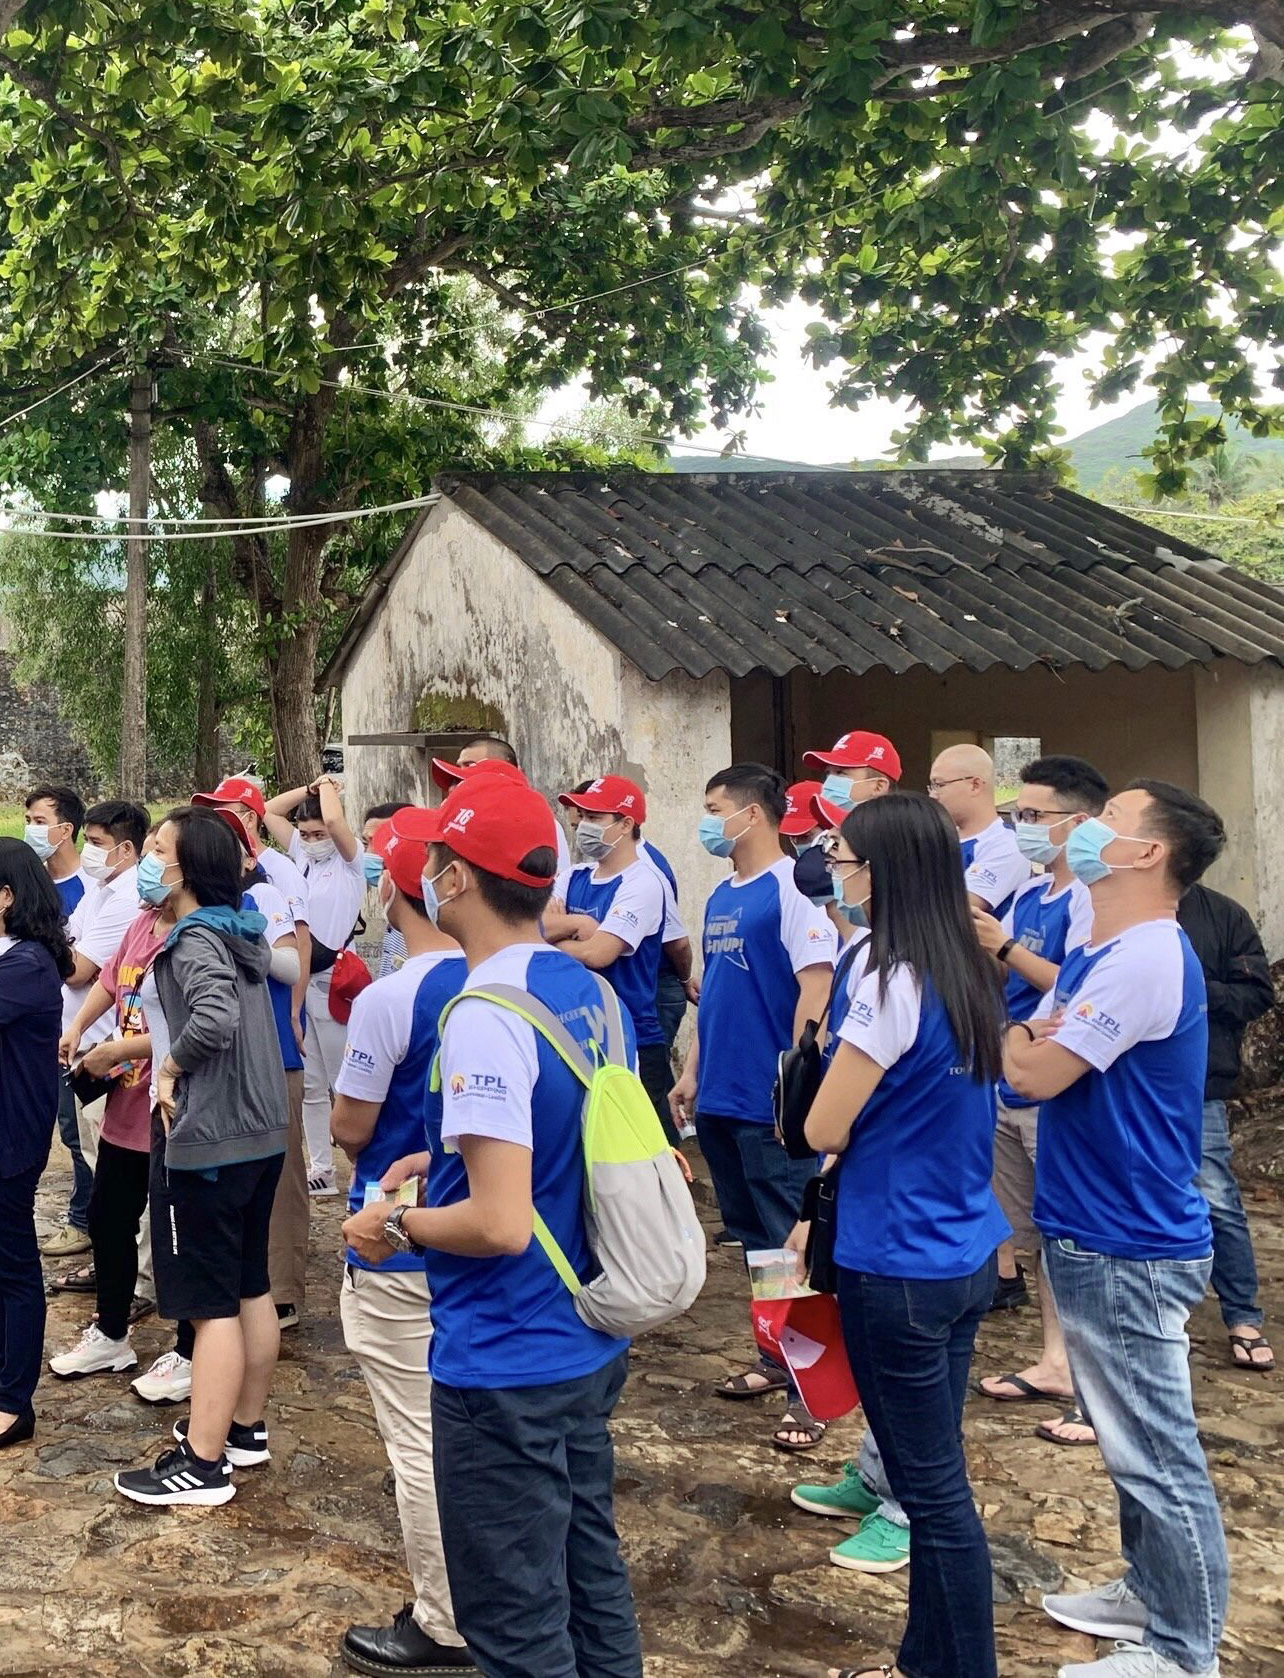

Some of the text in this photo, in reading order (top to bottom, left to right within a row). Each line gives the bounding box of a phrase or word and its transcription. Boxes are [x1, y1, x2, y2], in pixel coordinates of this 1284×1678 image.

[453, 807, 475, 826] 16
[1099, 1011, 1121, 1034] TPL
[352, 1049, 375, 1066] TPL
[471, 1074, 507, 1089] TPL
